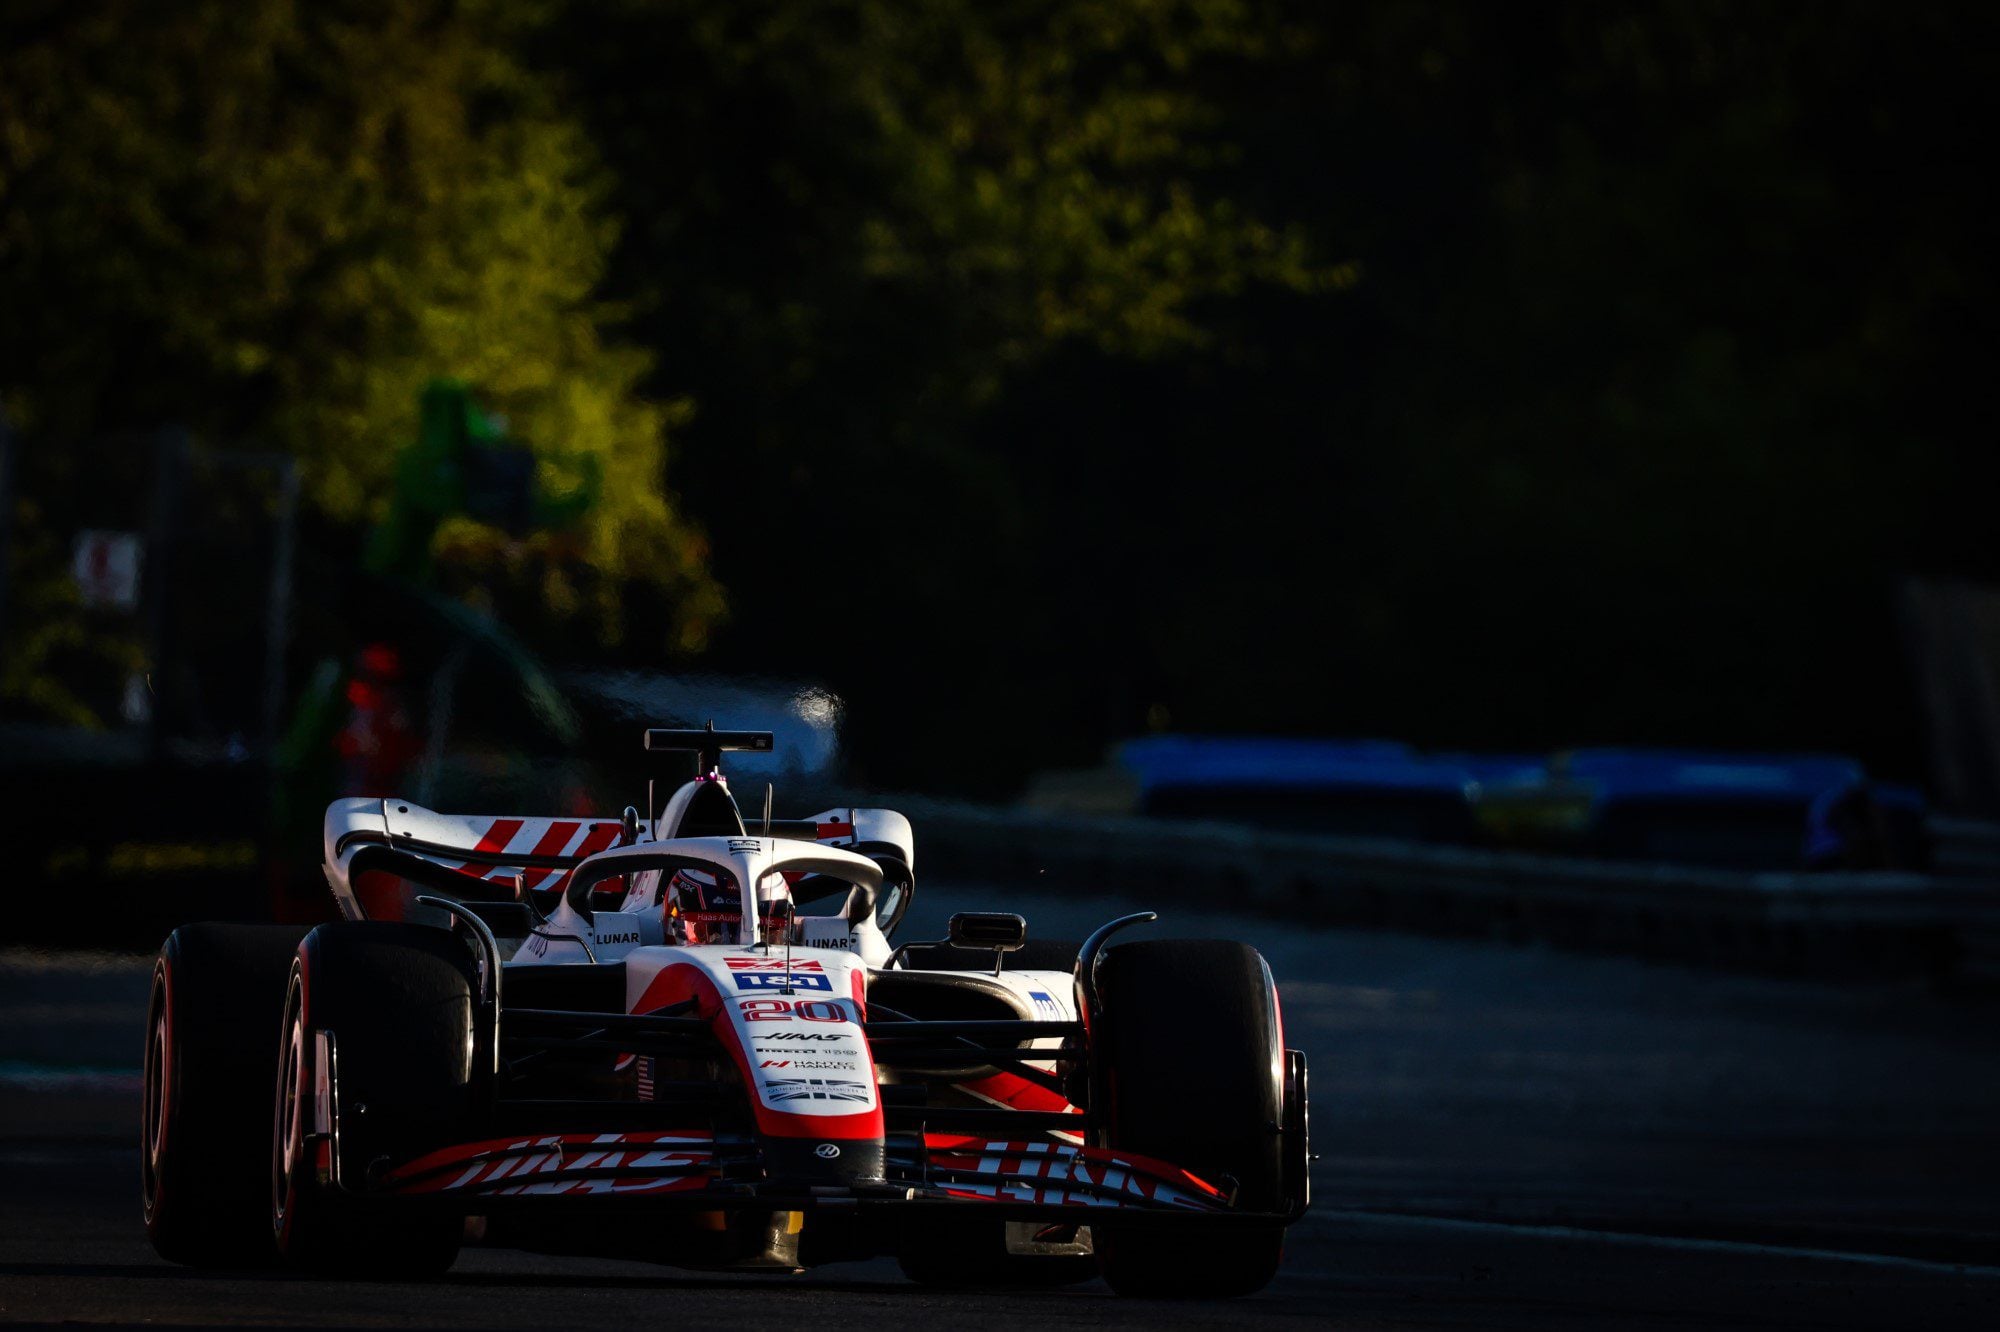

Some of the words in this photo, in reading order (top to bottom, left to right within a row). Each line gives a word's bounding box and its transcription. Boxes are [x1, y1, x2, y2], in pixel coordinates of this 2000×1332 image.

[596, 933, 639, 944] LUNAR
[805, 938, 848, 948] LUNAR
[739, 1000, 848, 1022] 20
[751, 1032, 852, 1041] HAAS
